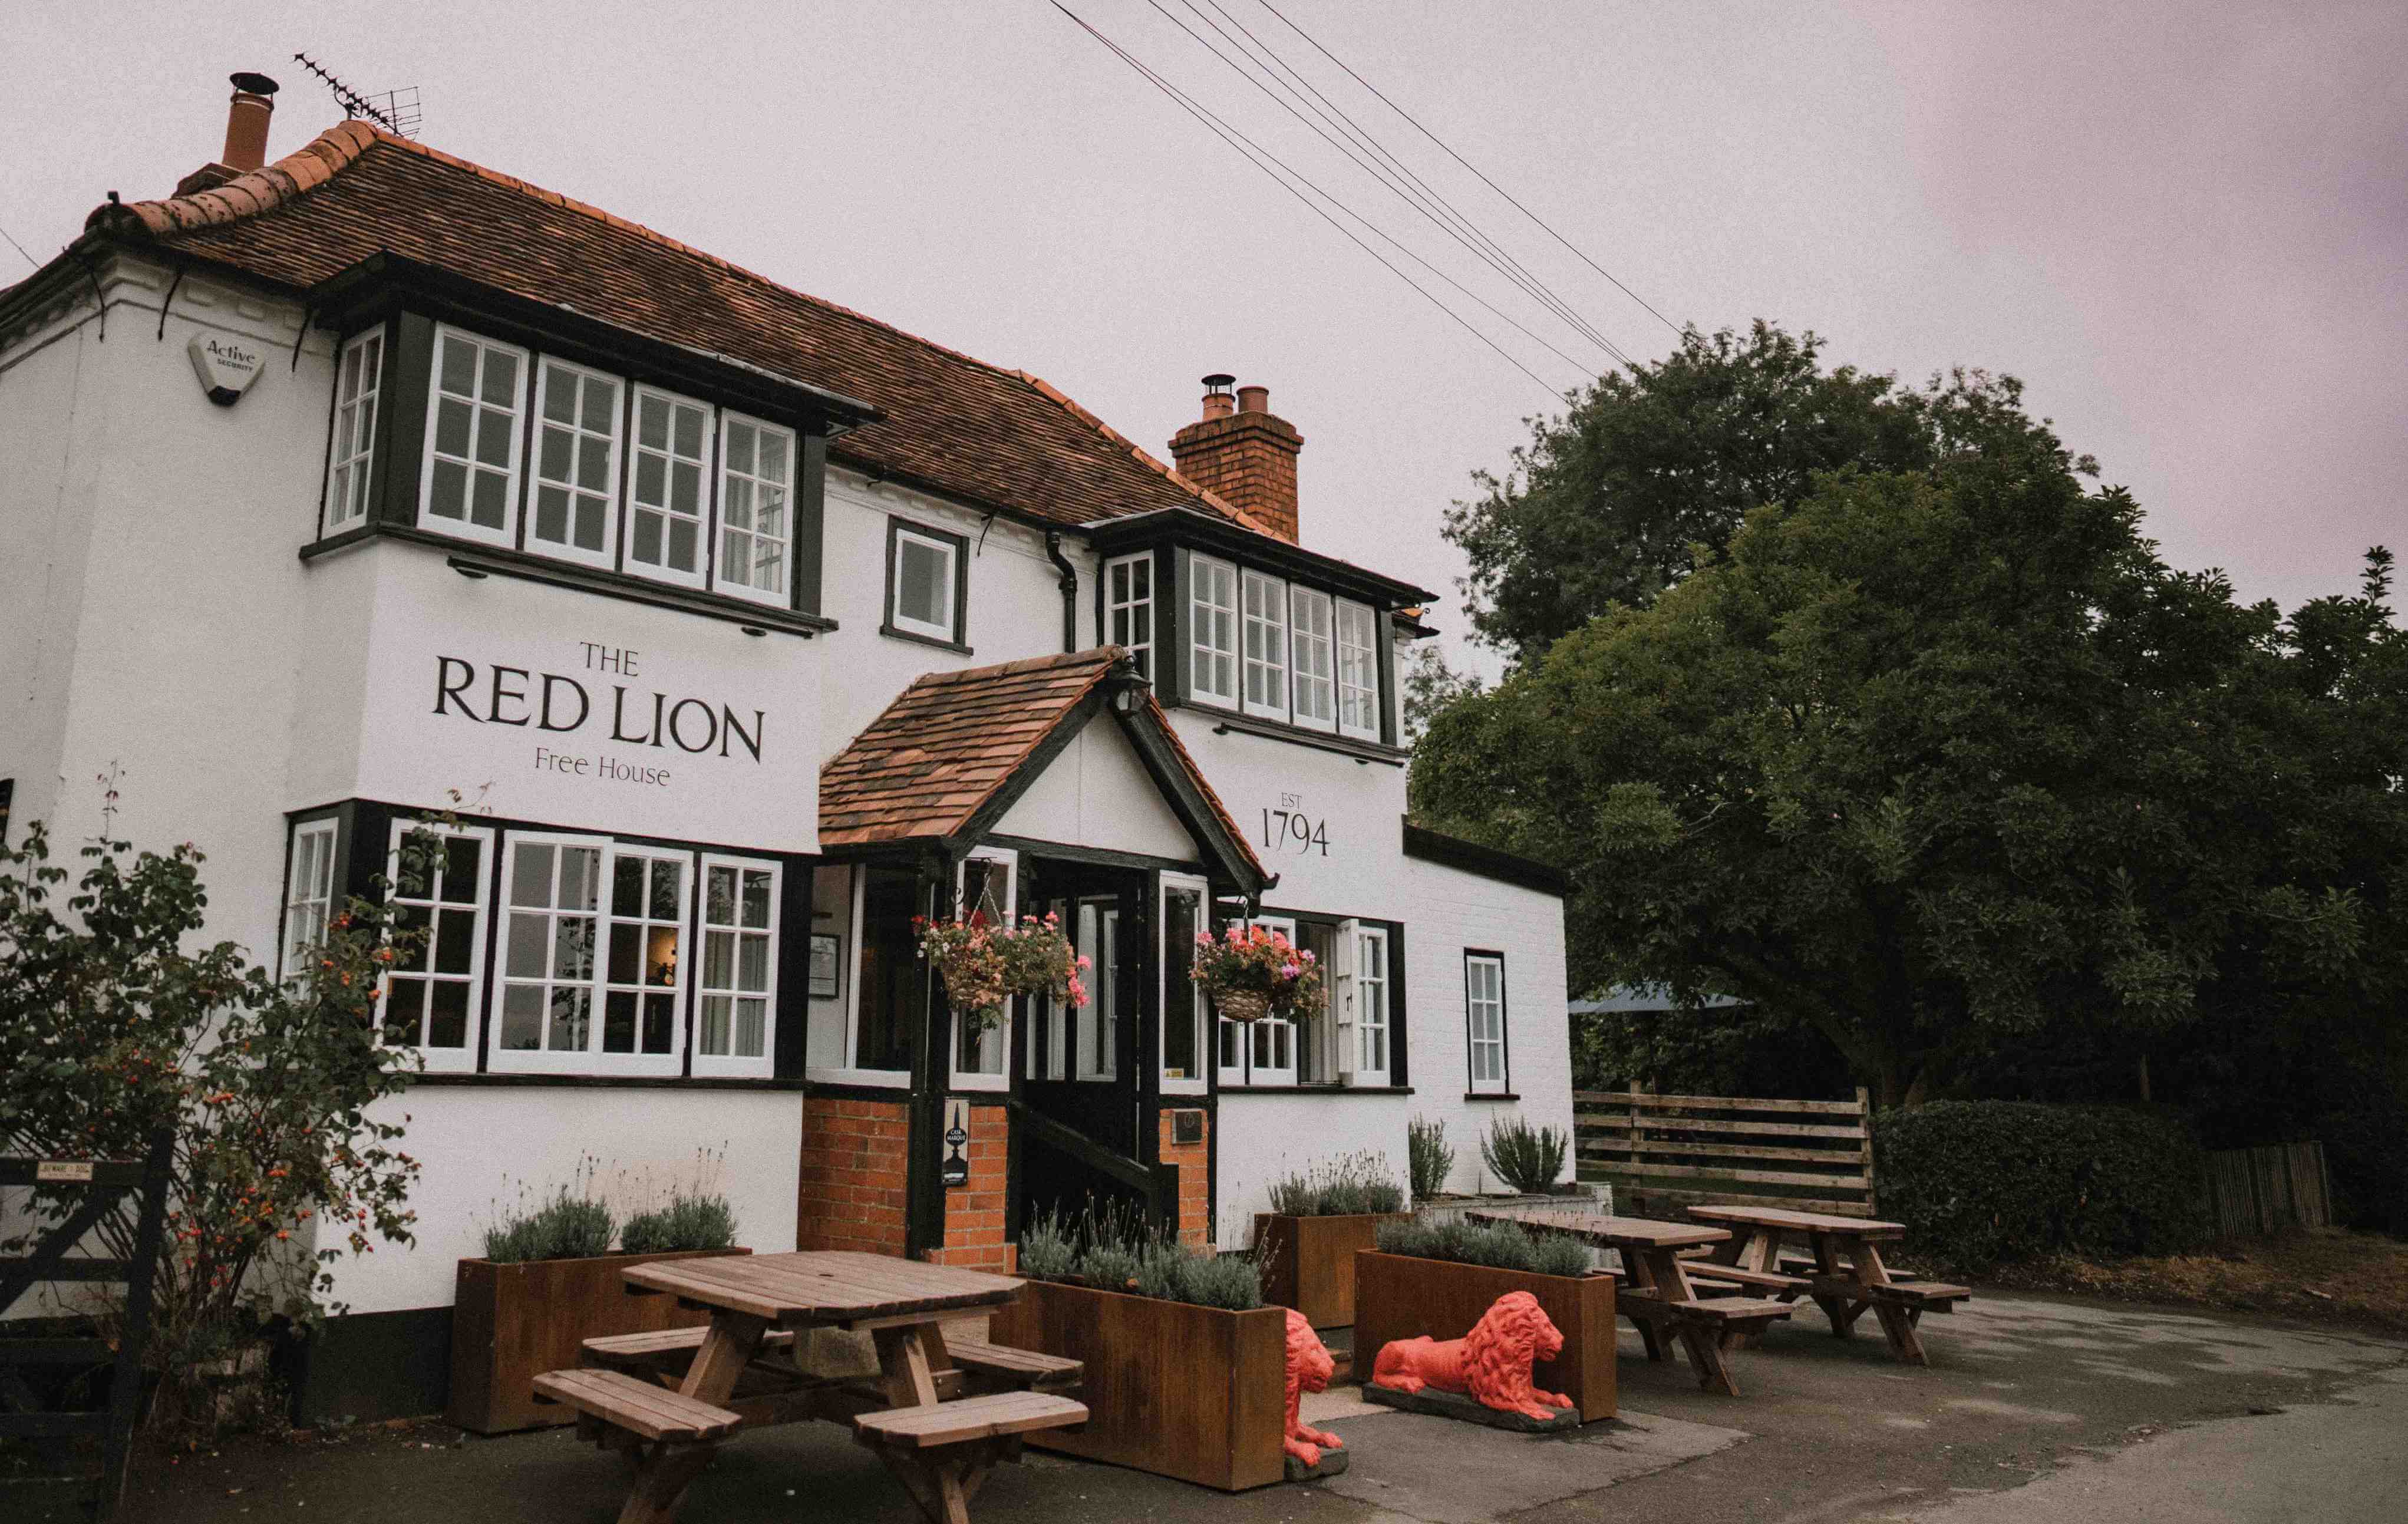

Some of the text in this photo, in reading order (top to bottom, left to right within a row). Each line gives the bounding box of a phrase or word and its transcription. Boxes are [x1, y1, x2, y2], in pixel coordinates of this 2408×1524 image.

[207, 340, 255, 364] Active
[217, 358, 253, 372] SECURITY
[580, 642, 638, 677] THE
[431, 656, 766, 764] RED LION
[536, 747, 670, 786] Free House
[1281, 792, 1302, 810] EST
[1262, 808, 1331, 857] 1794
